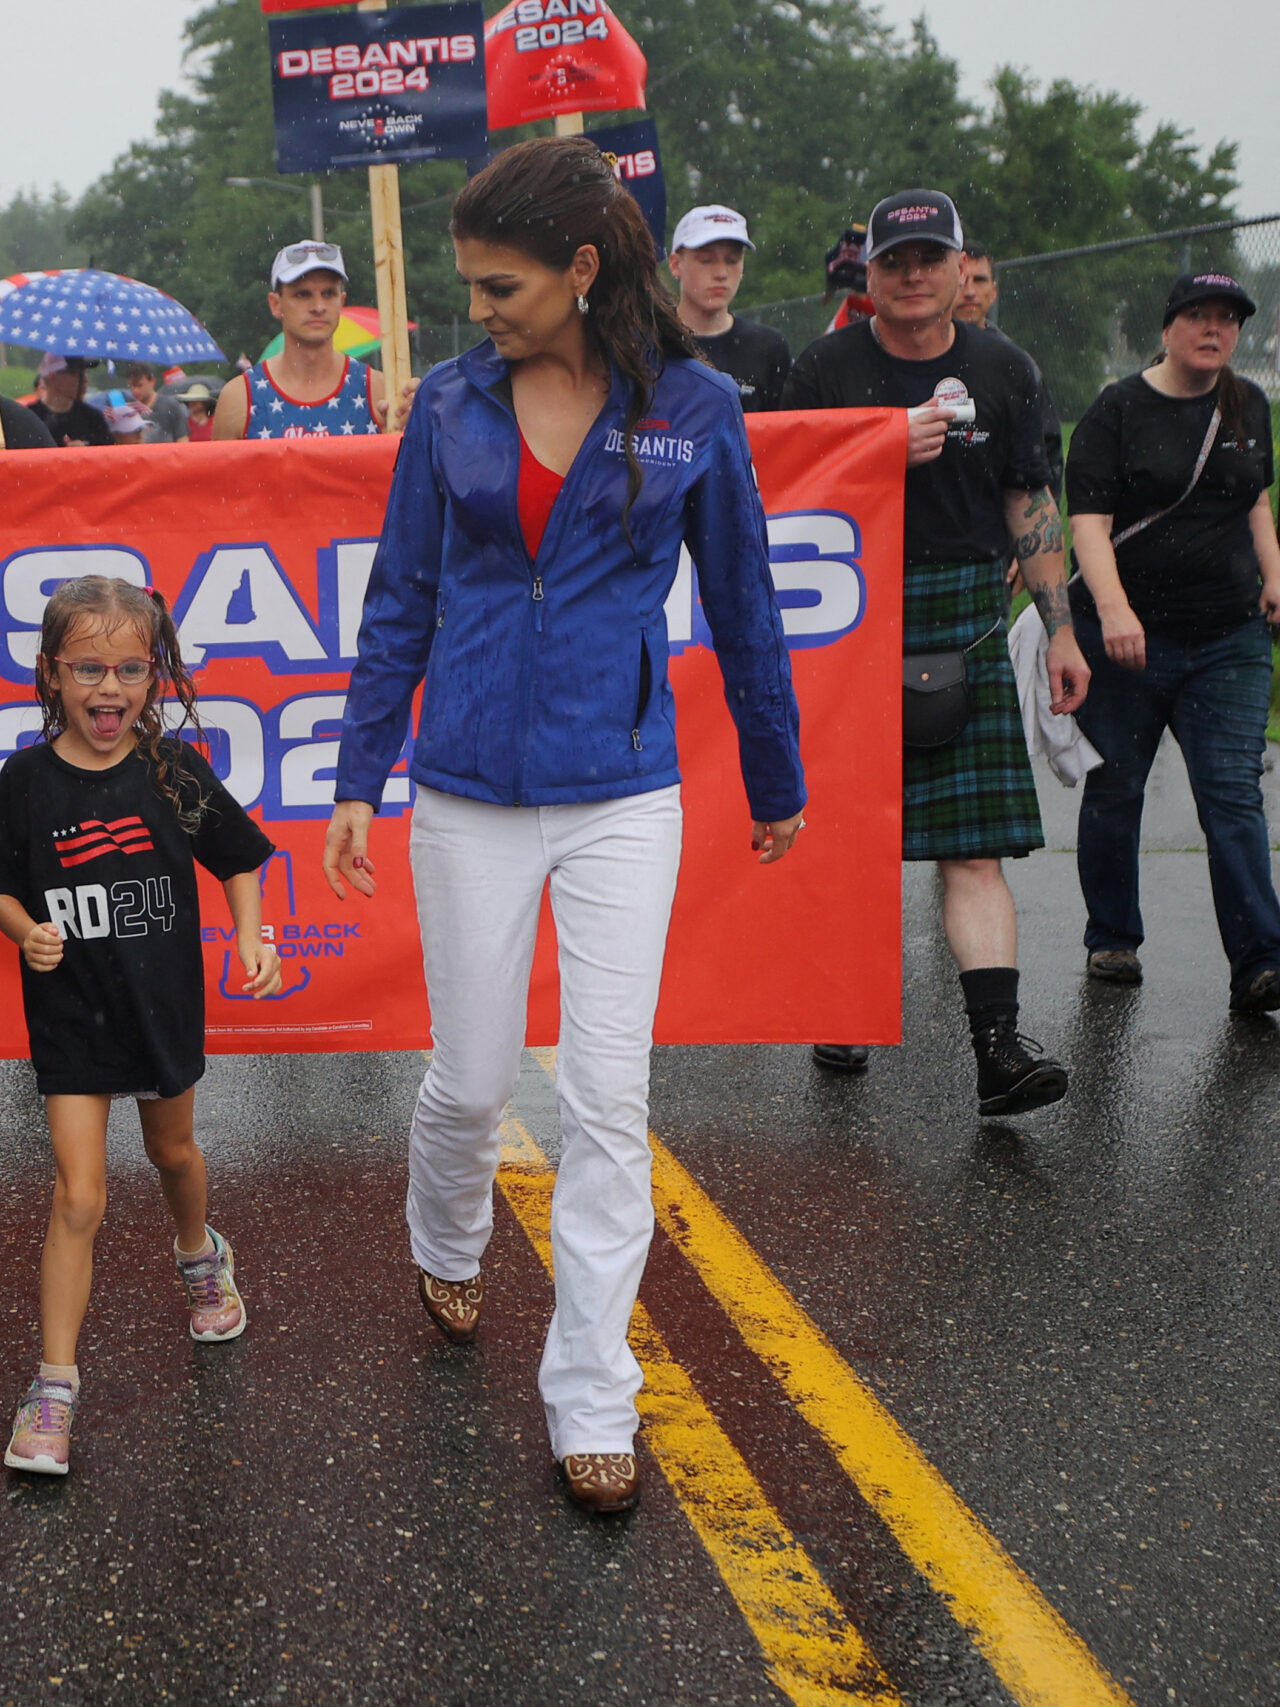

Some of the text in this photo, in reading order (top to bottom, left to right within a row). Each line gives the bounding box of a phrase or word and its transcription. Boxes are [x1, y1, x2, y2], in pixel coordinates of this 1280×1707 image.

[514, 16, 609, 53] 2024
[278, 34, 476, 78] DESANTIS
[329, 66, 429, 100] 2024
[339, 114, 423, 131] NEVER BACK
[44, 876, 176, 940] RD24
[283, 923, 361, 939] BACK
